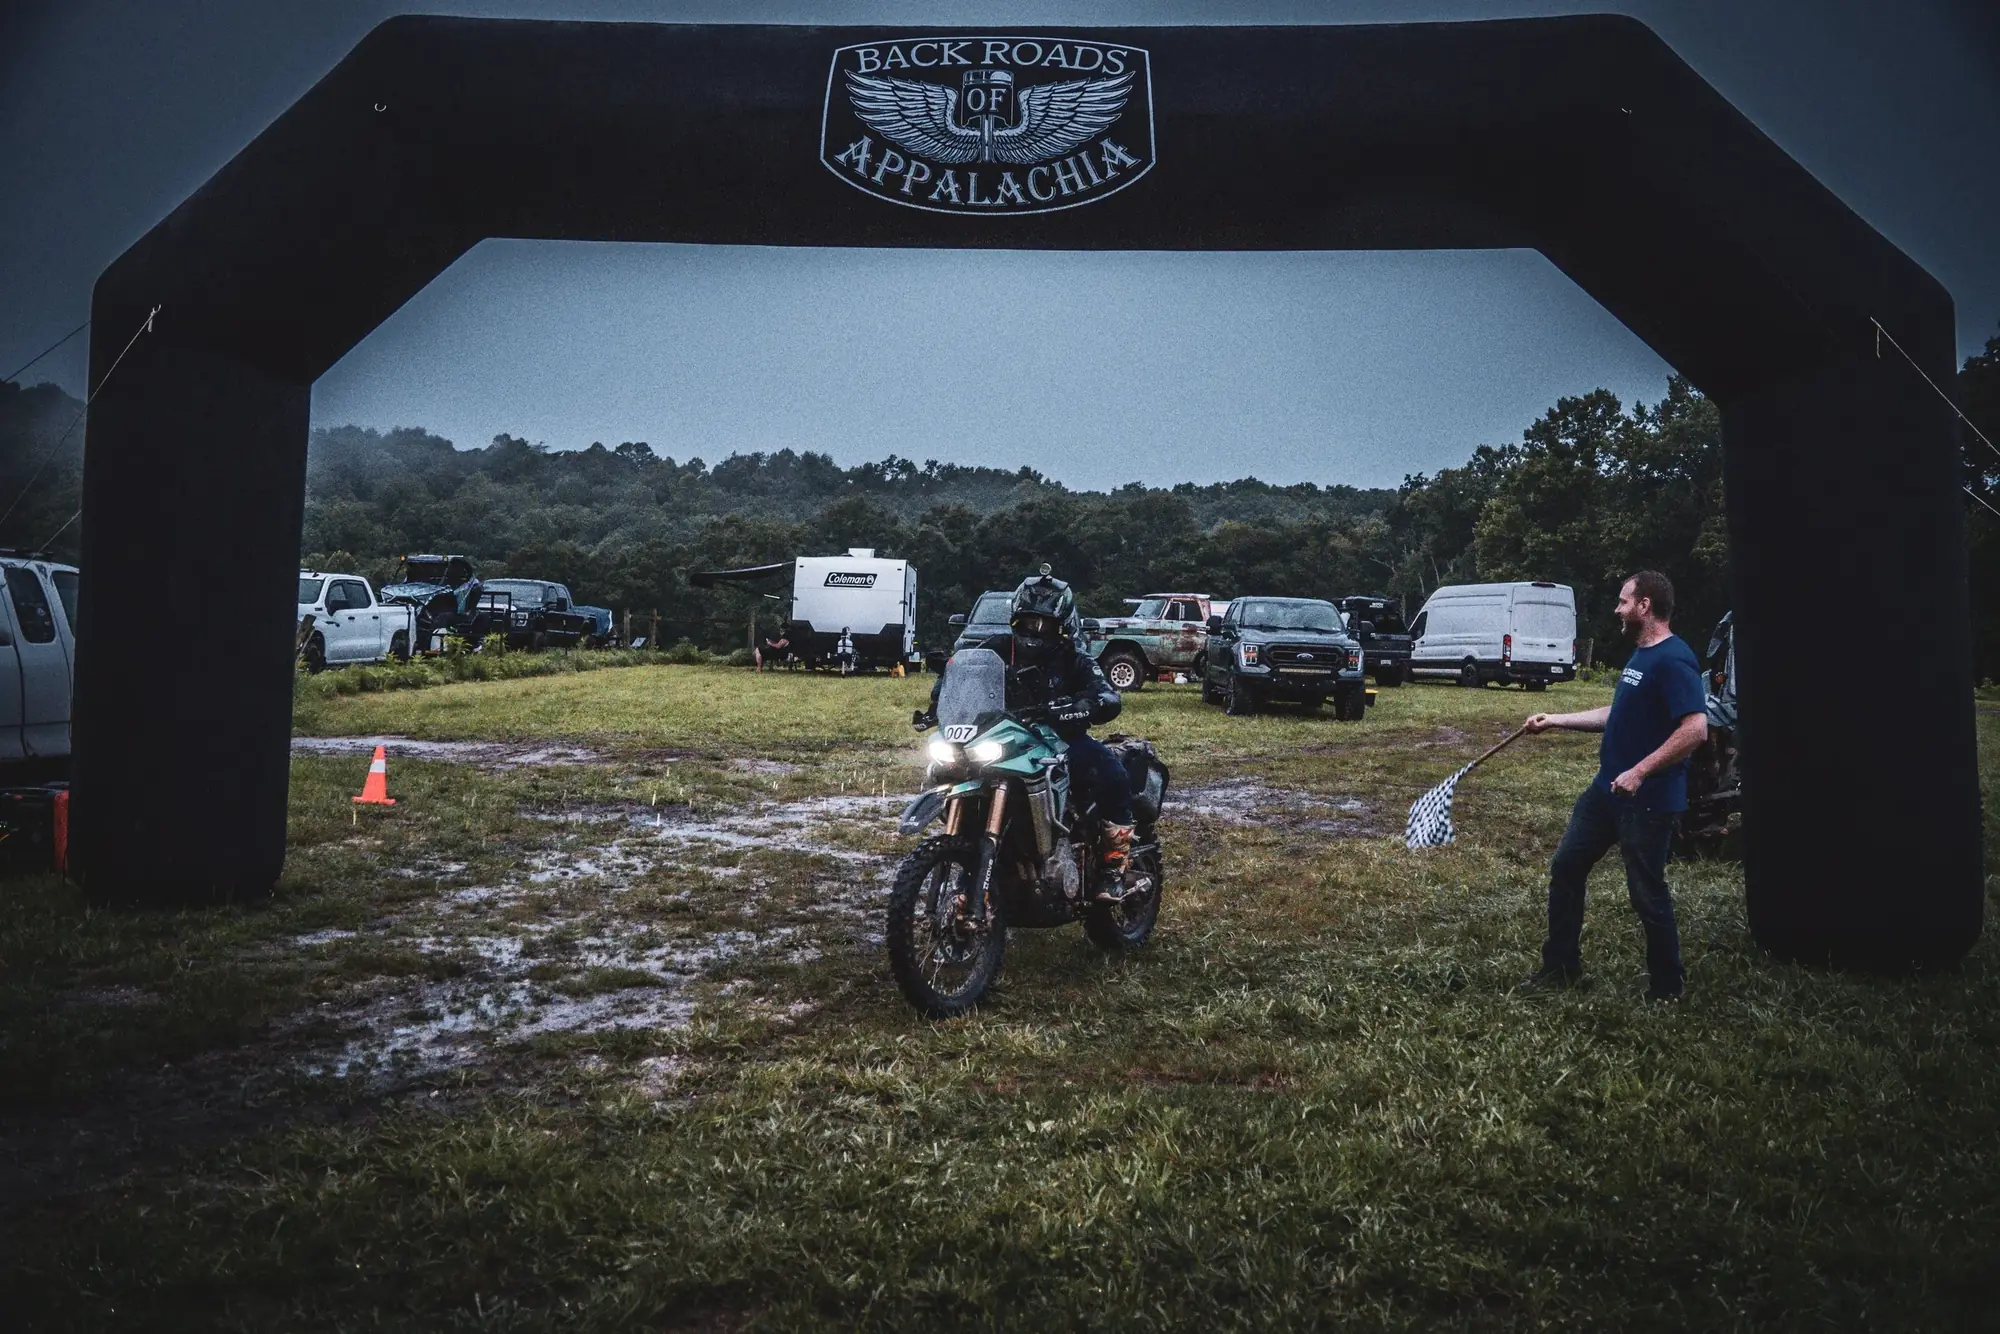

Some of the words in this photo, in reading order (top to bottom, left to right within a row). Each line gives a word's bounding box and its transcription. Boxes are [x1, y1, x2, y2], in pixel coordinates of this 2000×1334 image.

[855, 41, 973, 74] BACK
[981, 41, 1128, 75] ROADS
[966, 88, 1007, 112] OF
[833, 134, 1142, 207] APPALACHIA
[828, 573, 866, 584] Coleman
[947, 727, 973, 740] 007
